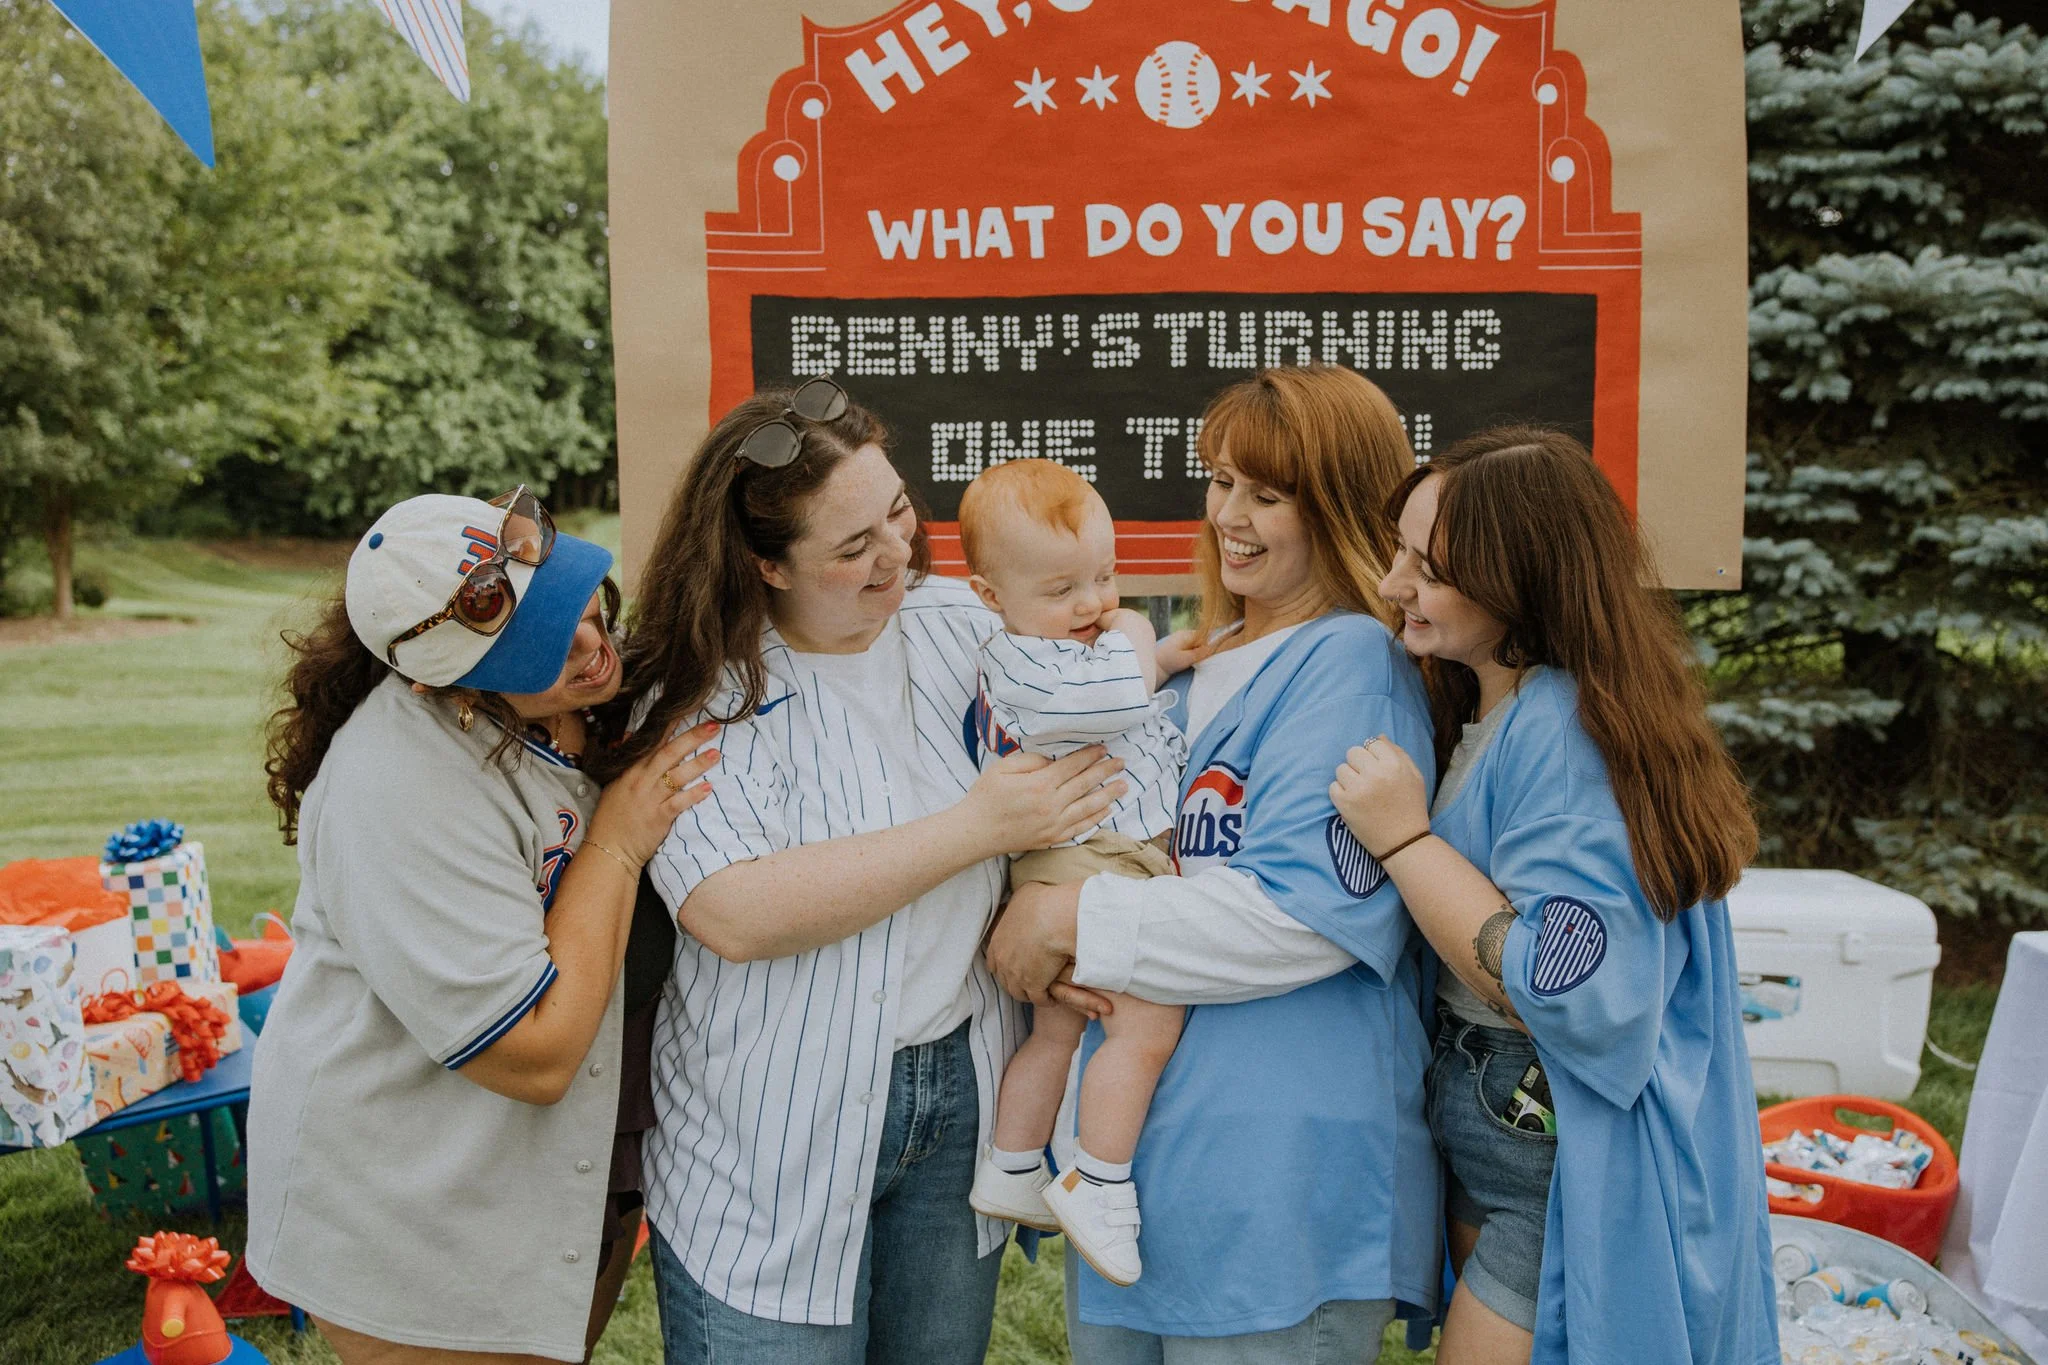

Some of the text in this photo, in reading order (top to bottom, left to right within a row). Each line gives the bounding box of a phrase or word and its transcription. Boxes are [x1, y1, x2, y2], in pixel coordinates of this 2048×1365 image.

[867, 194, 1527, 261] WHAT DO YOU SAY?
[790, 308, 1501, 376] BENNY'S TURNING
[930, 418, 1098, 483] ONE
